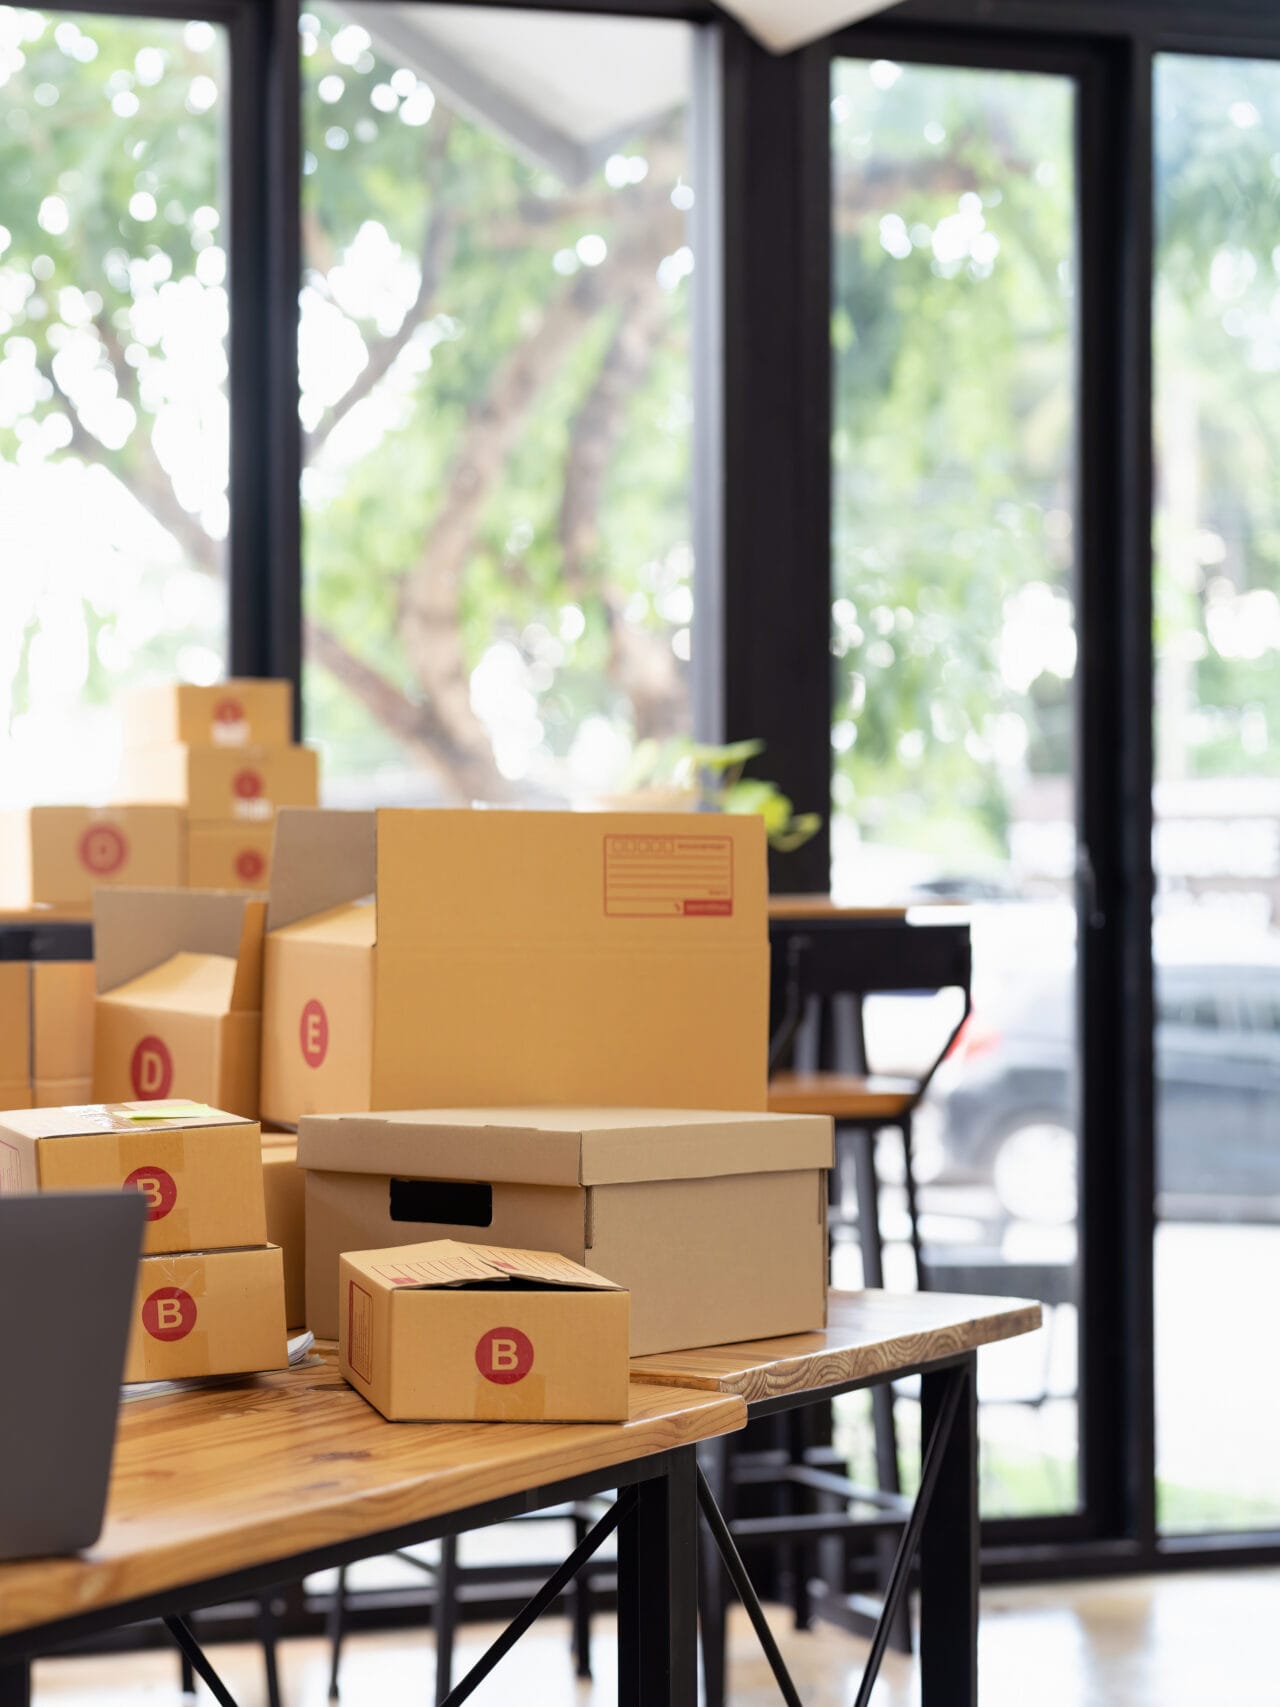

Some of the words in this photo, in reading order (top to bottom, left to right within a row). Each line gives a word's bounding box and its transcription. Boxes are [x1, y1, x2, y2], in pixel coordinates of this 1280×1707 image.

[306, 1014, 322, 1054] E
[140, 1051, 163, 1093] D
[136, 1178, 163, 1208] B
[156, 1298, 183, 1329] B
[491, 1339, 519, 1371] B
